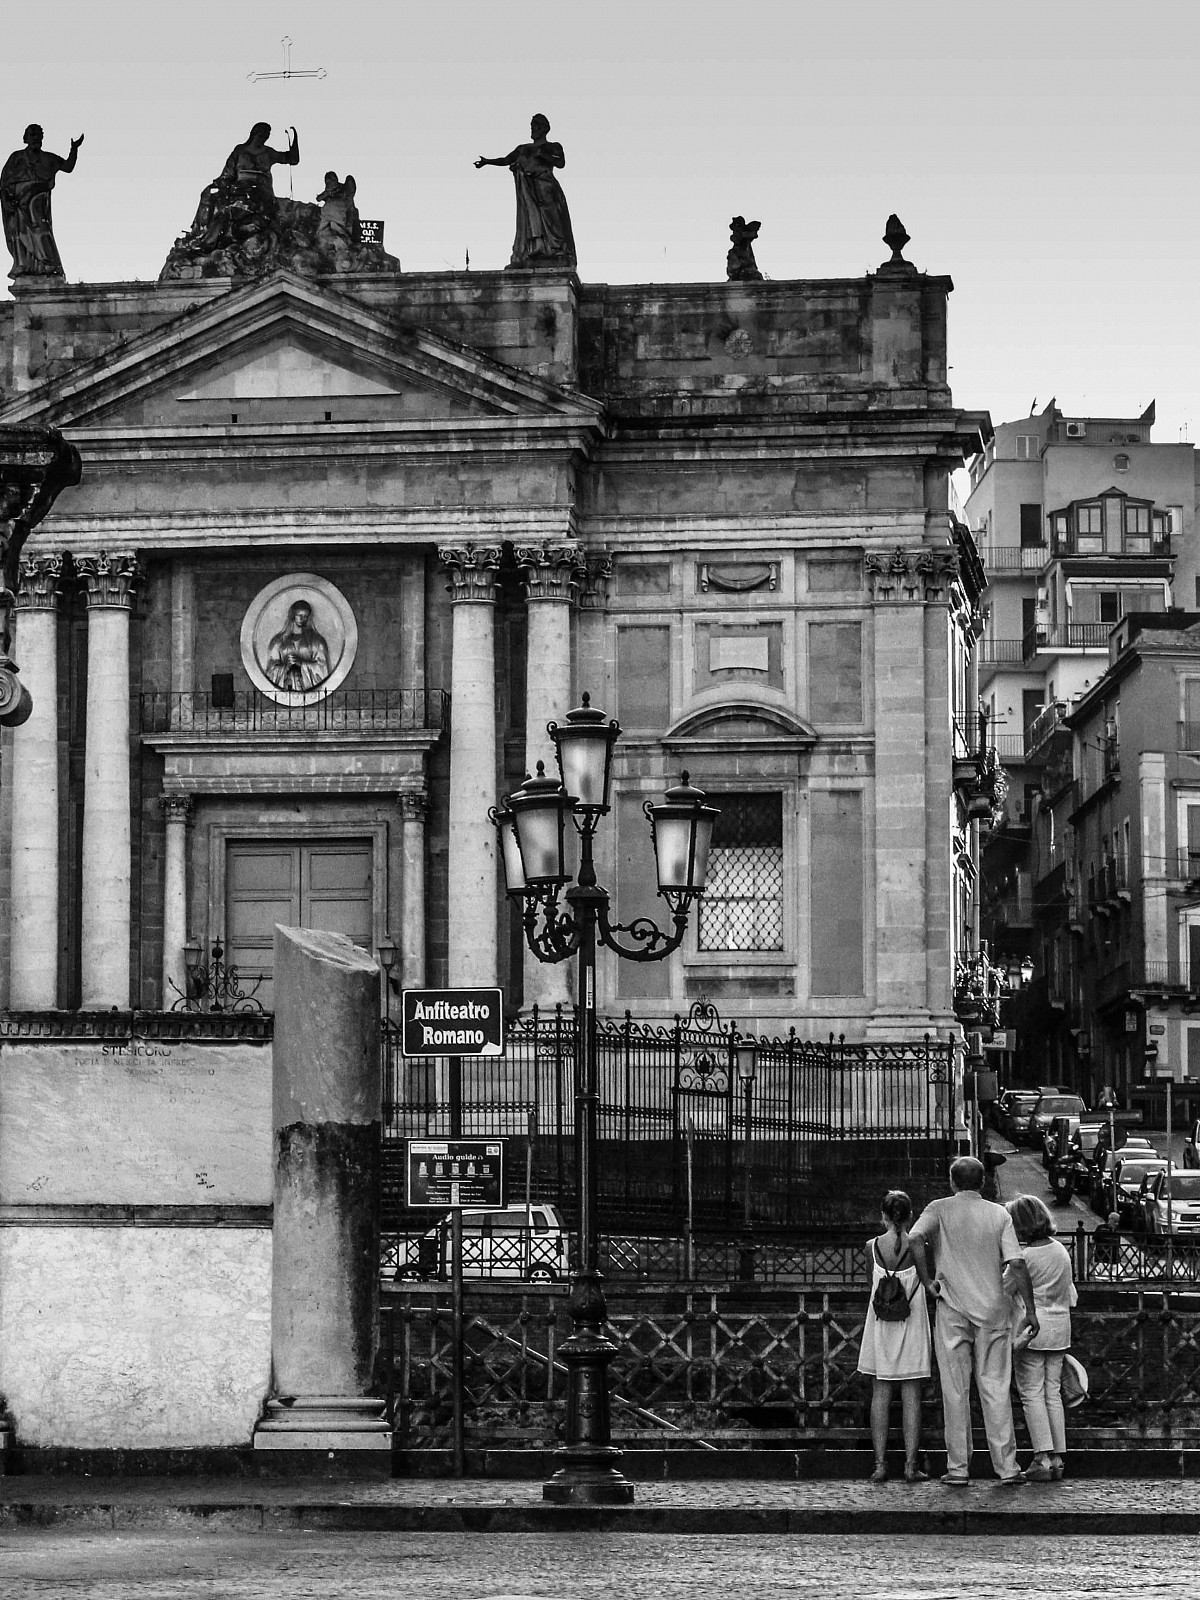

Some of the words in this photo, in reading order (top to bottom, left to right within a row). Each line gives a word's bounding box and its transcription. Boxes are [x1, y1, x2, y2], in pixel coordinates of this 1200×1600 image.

[413, 1000, 490, 1020] Anfiteatro
[423, 1027, 485, 1046] Romano
[102, 1045, 172, 1057] STESICORO
[432, 1153, 455, 1161] Audio
[455, 1153, 477, 1162] guide
